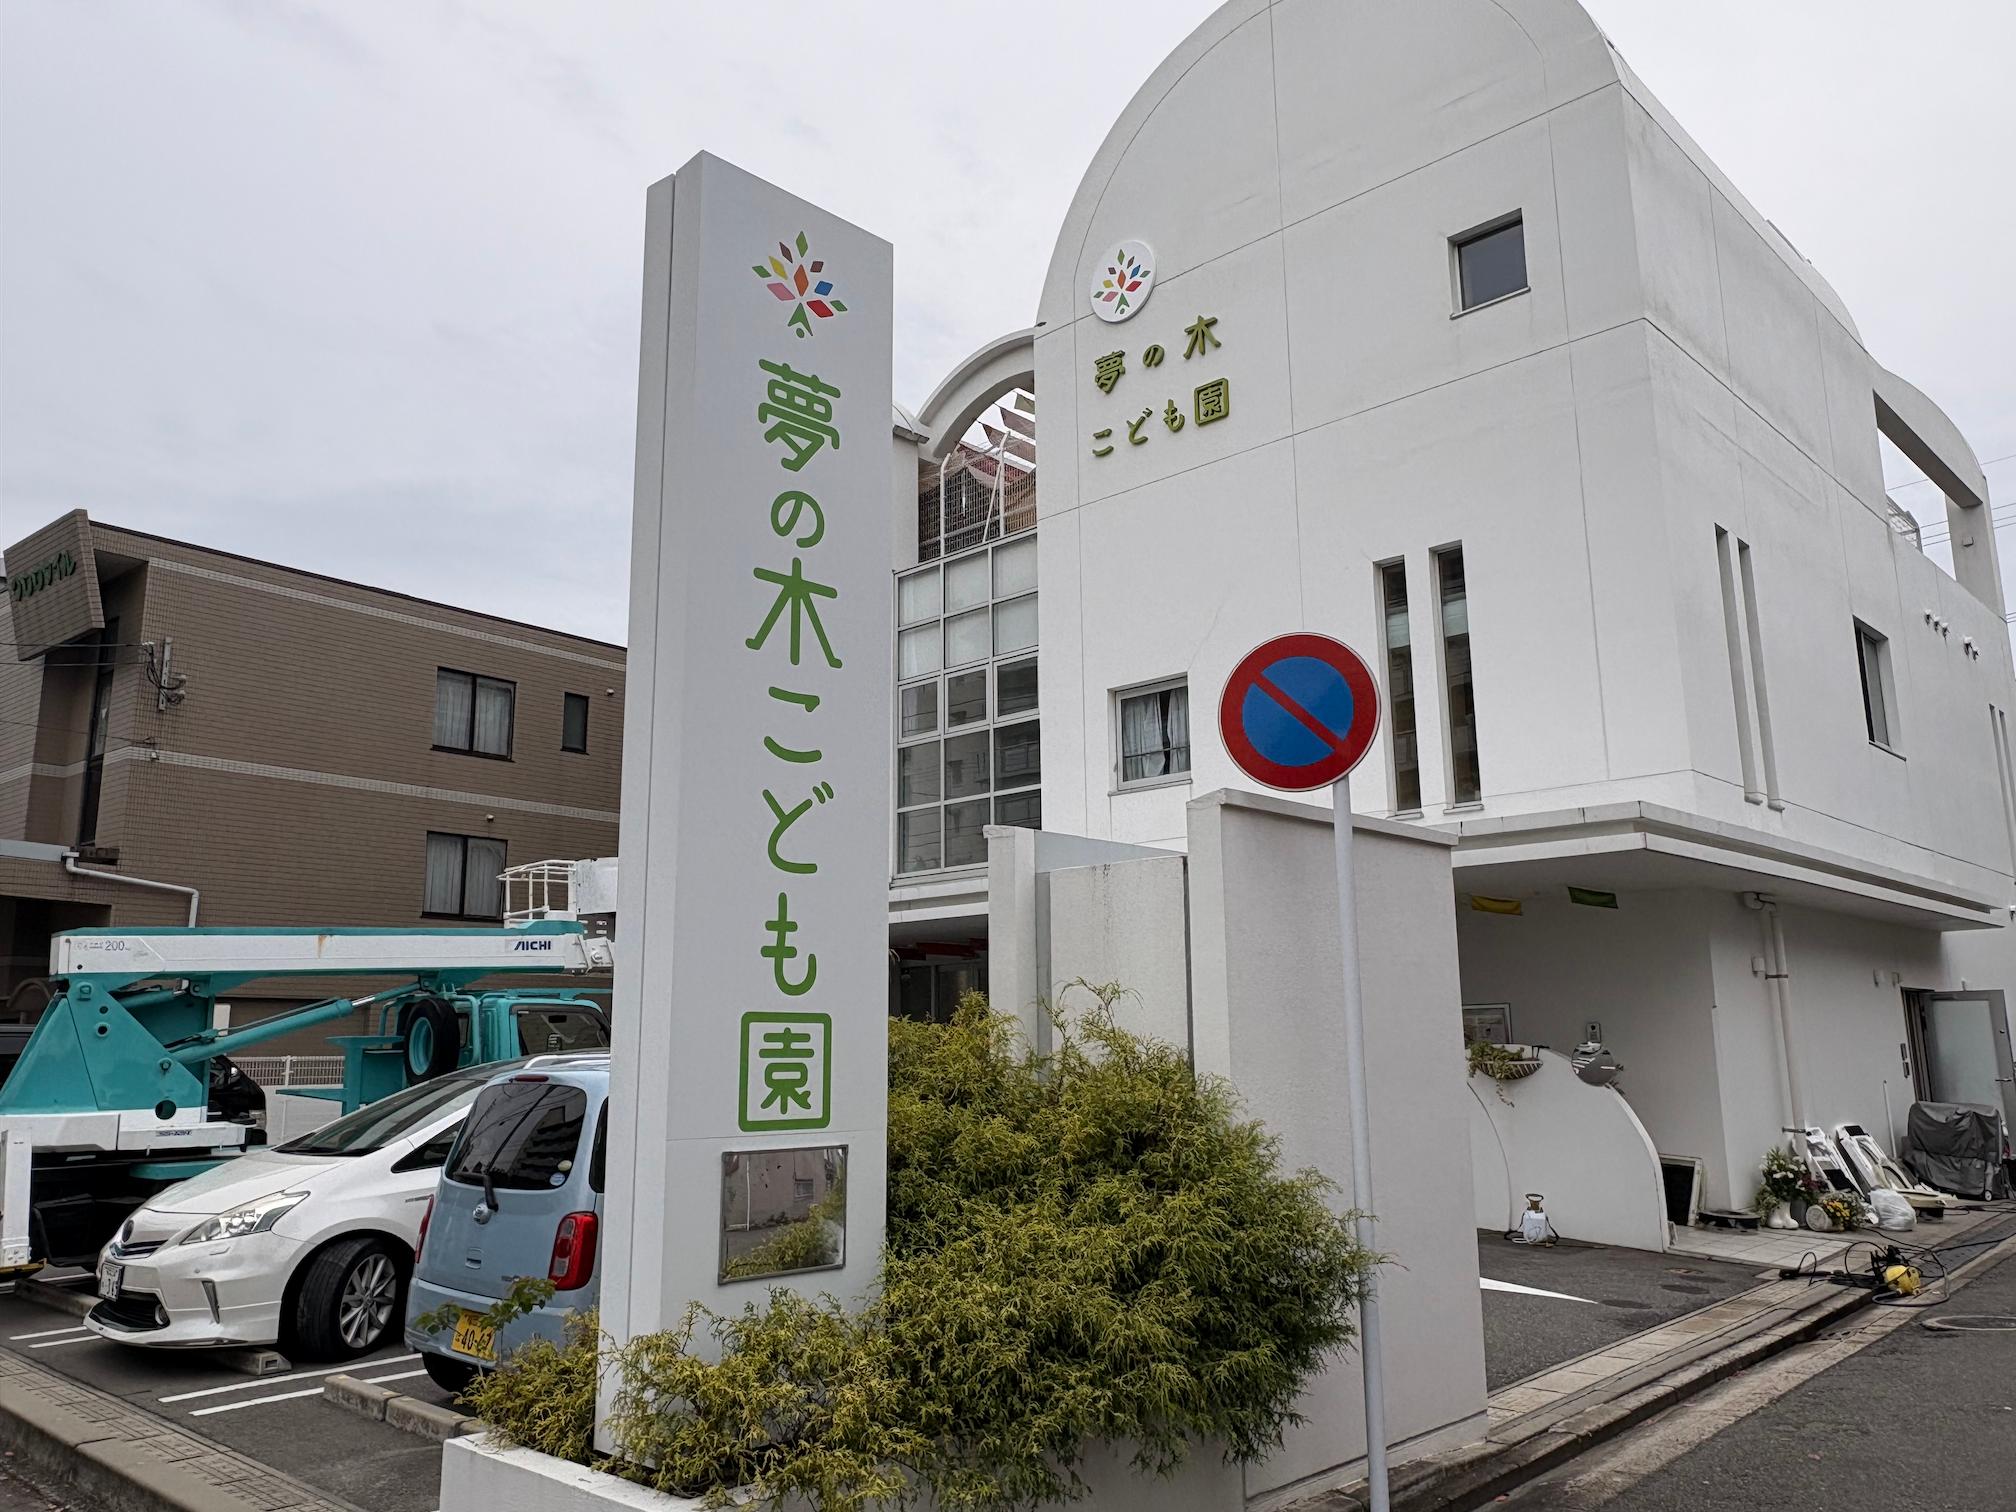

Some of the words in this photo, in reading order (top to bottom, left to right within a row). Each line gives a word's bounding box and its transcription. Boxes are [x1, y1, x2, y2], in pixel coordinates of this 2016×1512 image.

[1093, 314, 1223, 394] 夢の木
[1092, 377, 1230, 457] こども園
[740, 357, 843, 1133] 夢の木こども園
[104, 940, 125, 951] 200
[513, 940, 552, 951] AICHI
